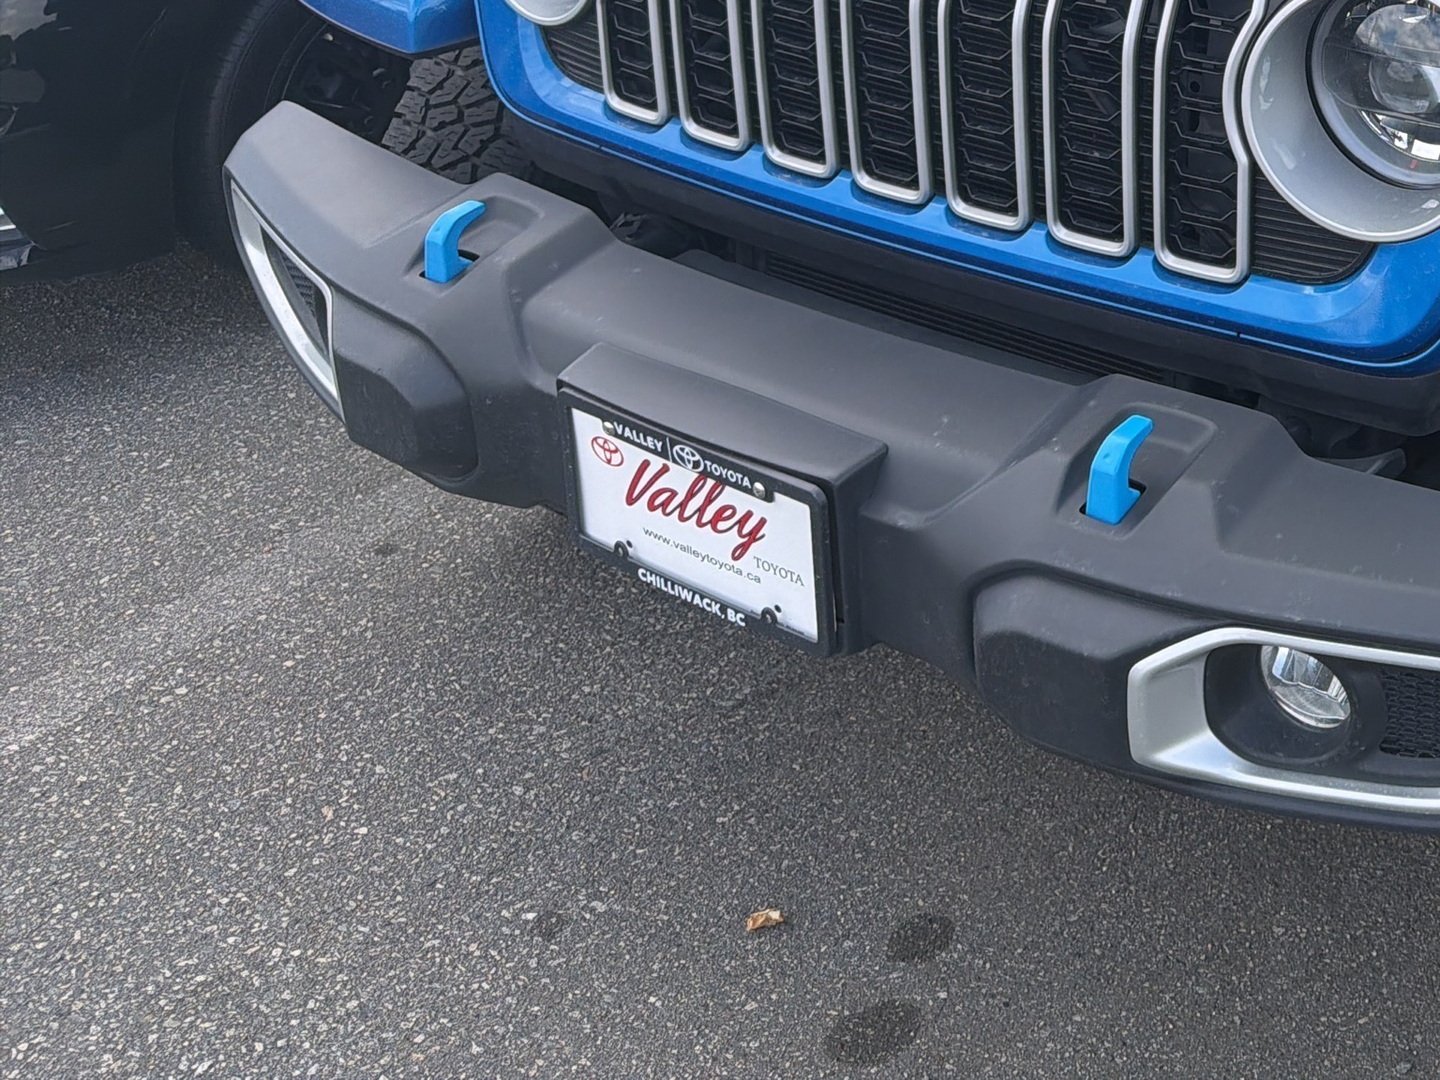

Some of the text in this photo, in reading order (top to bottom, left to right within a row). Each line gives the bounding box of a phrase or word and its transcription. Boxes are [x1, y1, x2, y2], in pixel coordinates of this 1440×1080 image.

[614, 422, 752, 488] VALLEY TOYOTA
[625, 459, 768, 561] Valley
[643, 527, 762, 585] www.valleytoyota.ca
[753, 556, 805, 587] TOYOTA
[726, 609, 746, 627] BC
